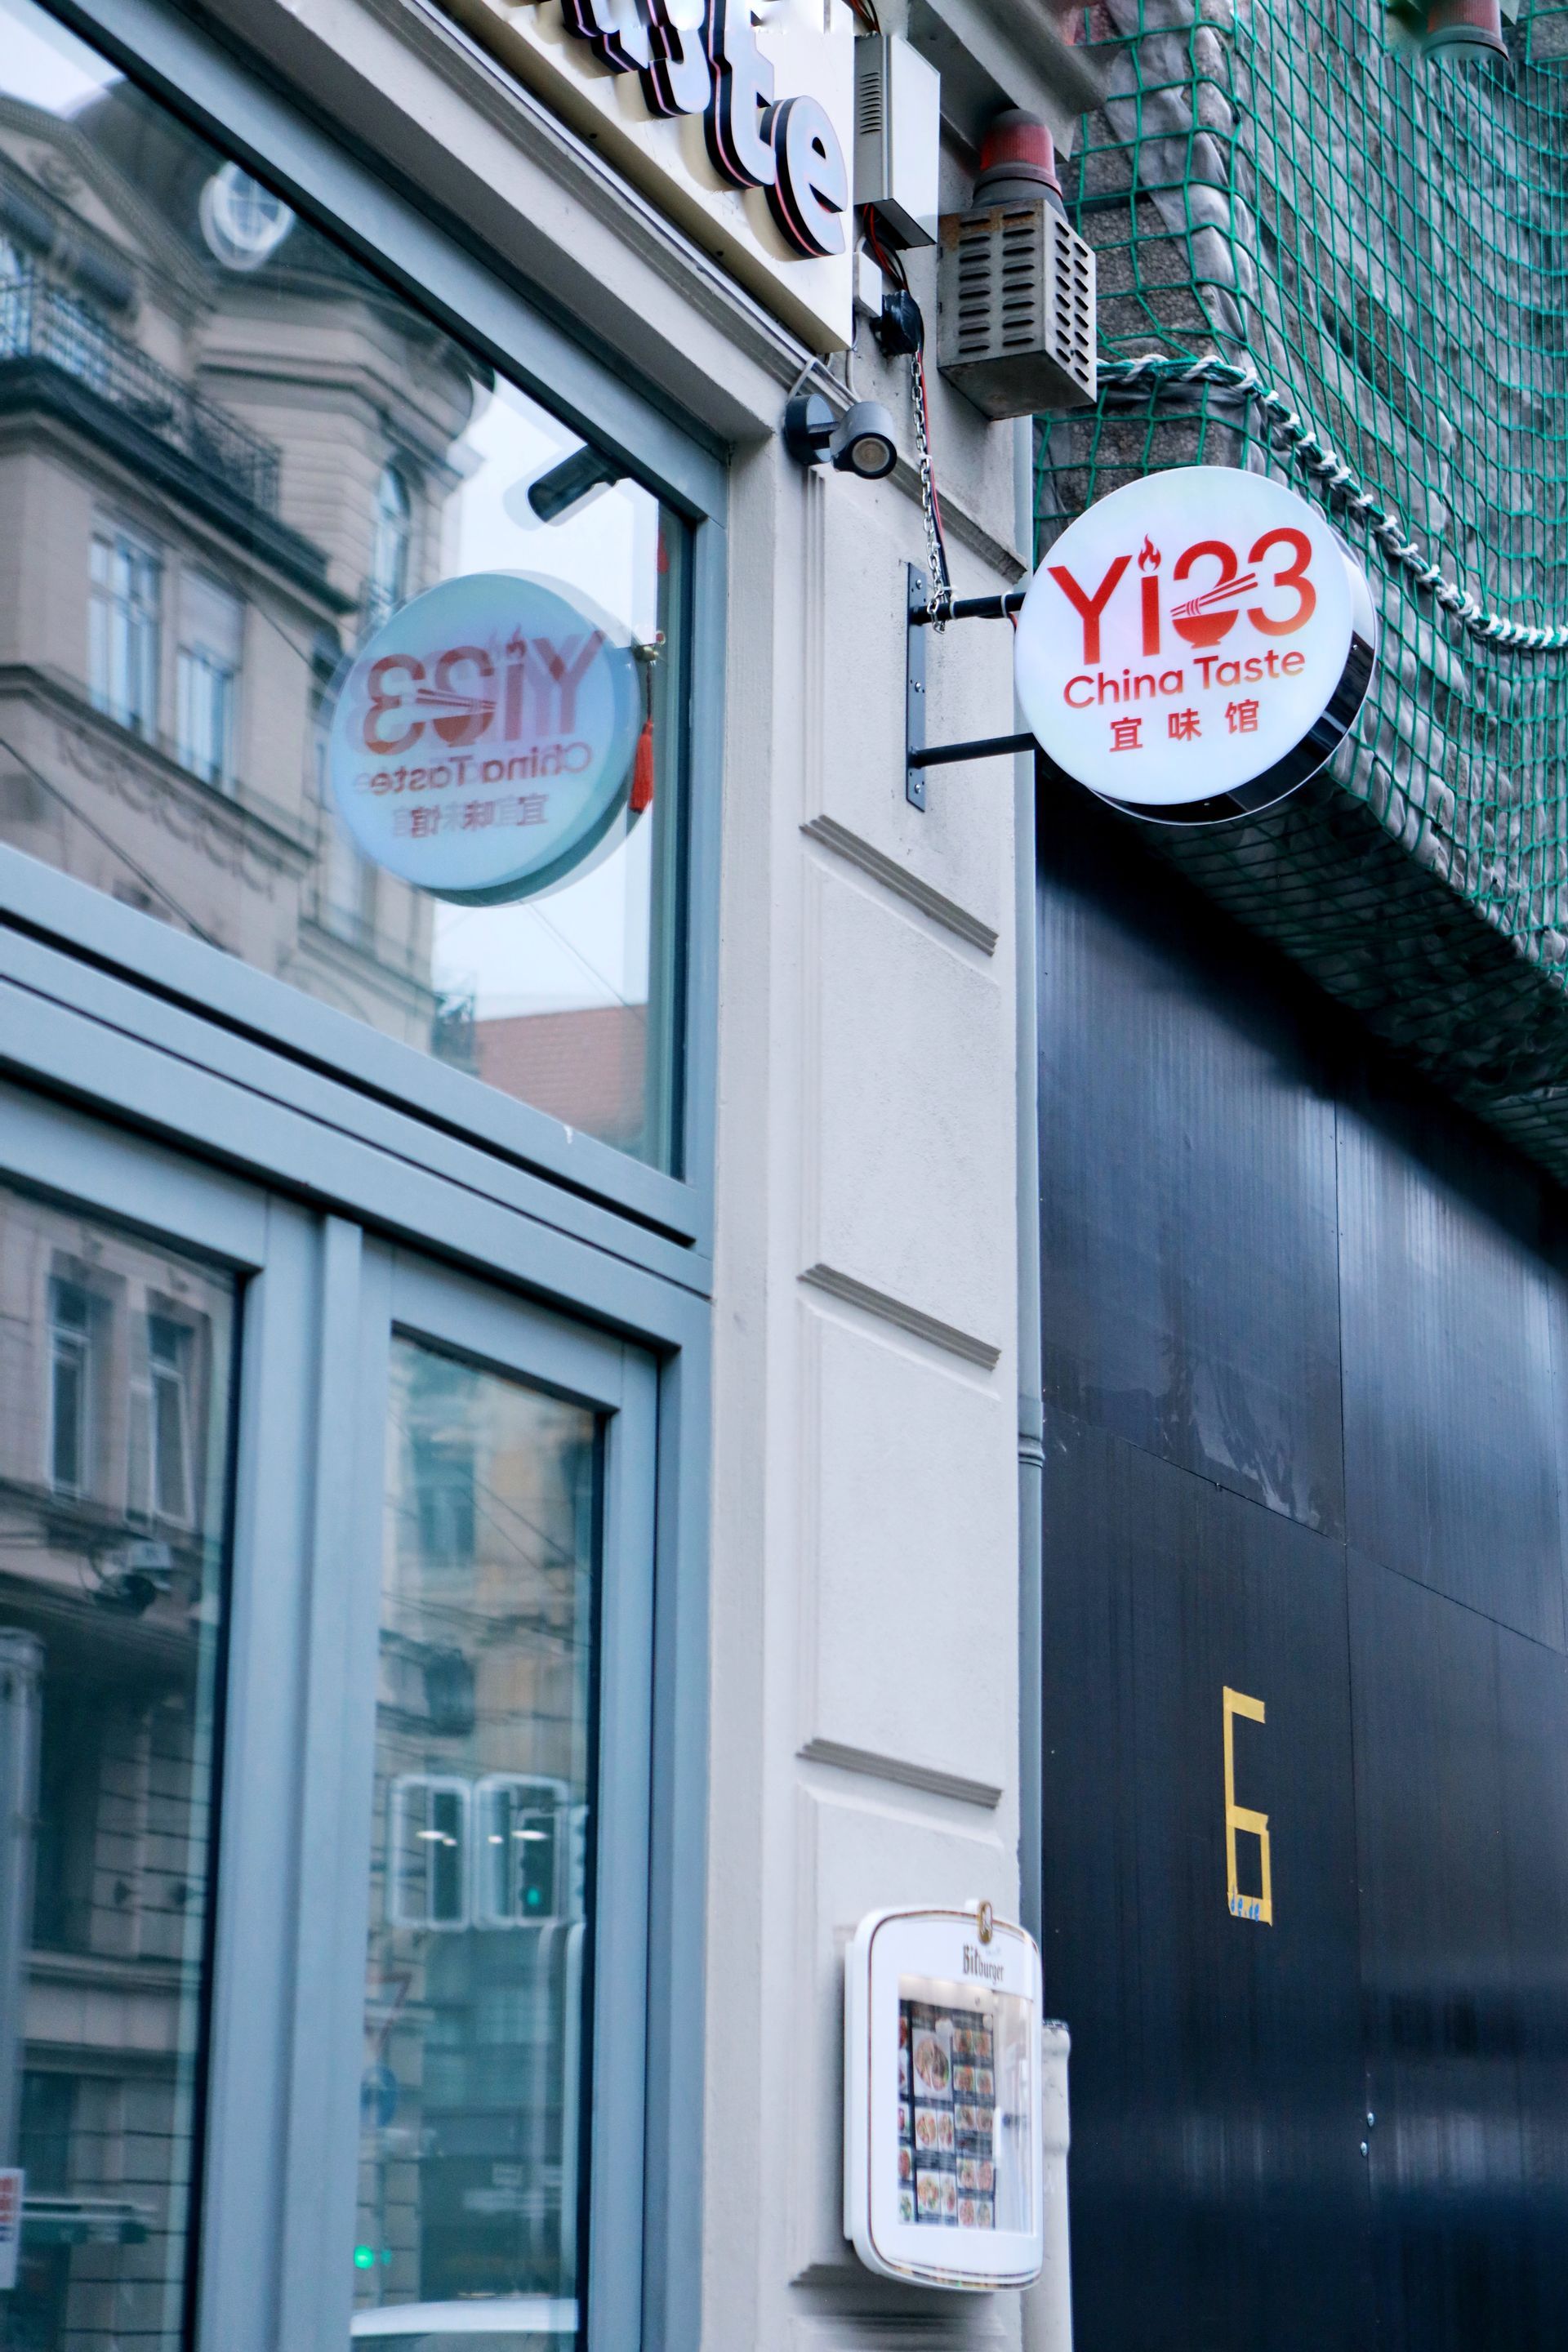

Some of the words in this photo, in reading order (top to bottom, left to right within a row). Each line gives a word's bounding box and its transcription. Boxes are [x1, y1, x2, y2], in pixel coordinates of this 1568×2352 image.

[1063, 669, 1184, 710] China
[1192, 650, 1306, 690] Taste
[1109, 700, 1260, 753] 宜味馆
[963, 1944, 1004, 1985] Bitburger
